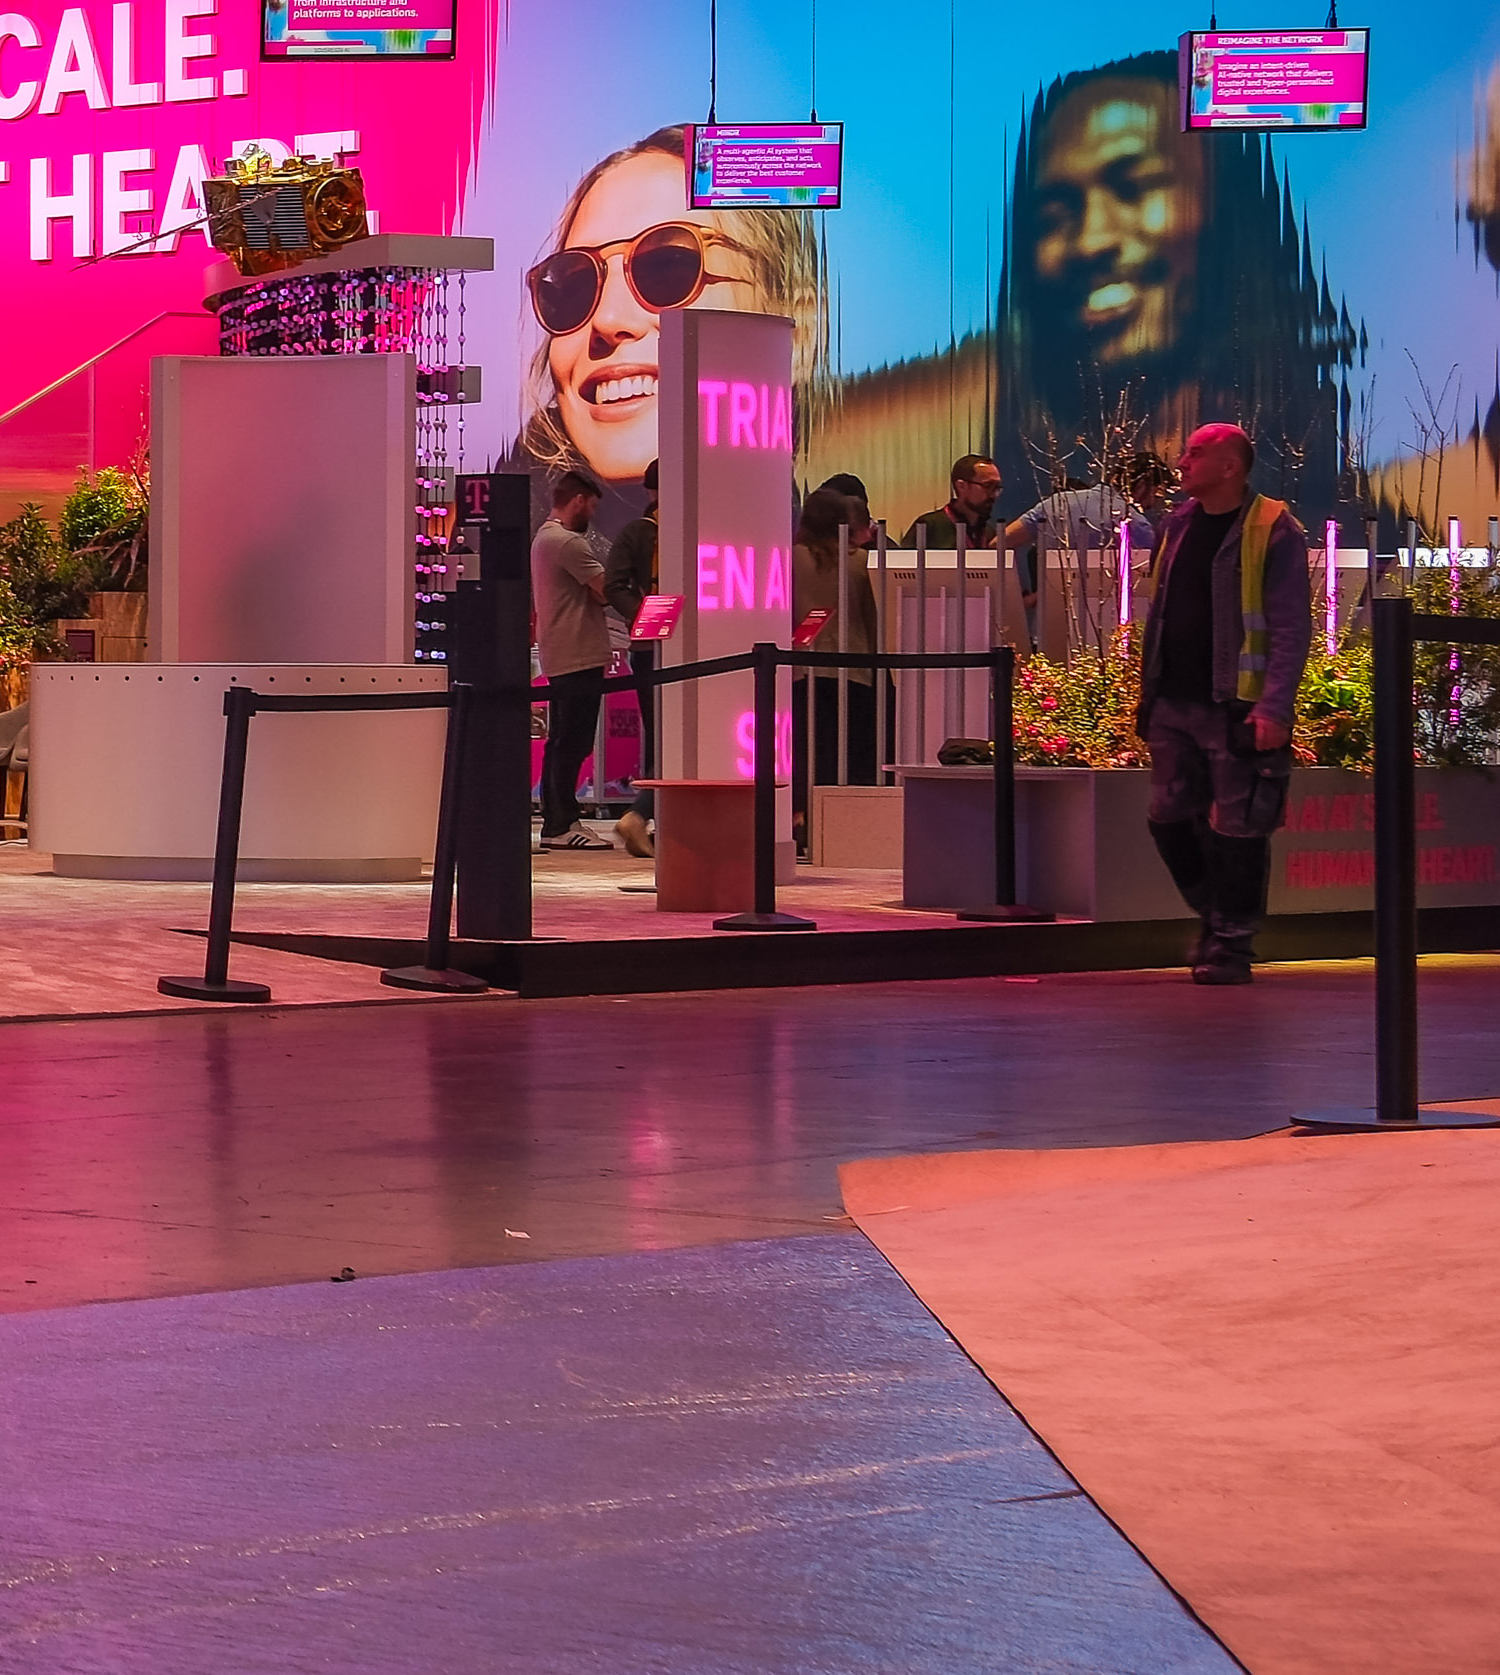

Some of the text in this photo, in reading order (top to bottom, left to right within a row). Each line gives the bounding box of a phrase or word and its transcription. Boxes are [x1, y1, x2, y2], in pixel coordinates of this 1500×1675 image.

[293, 7, 418, 20] platforms to applications.
[698, 380, 792, 450] TRIA
